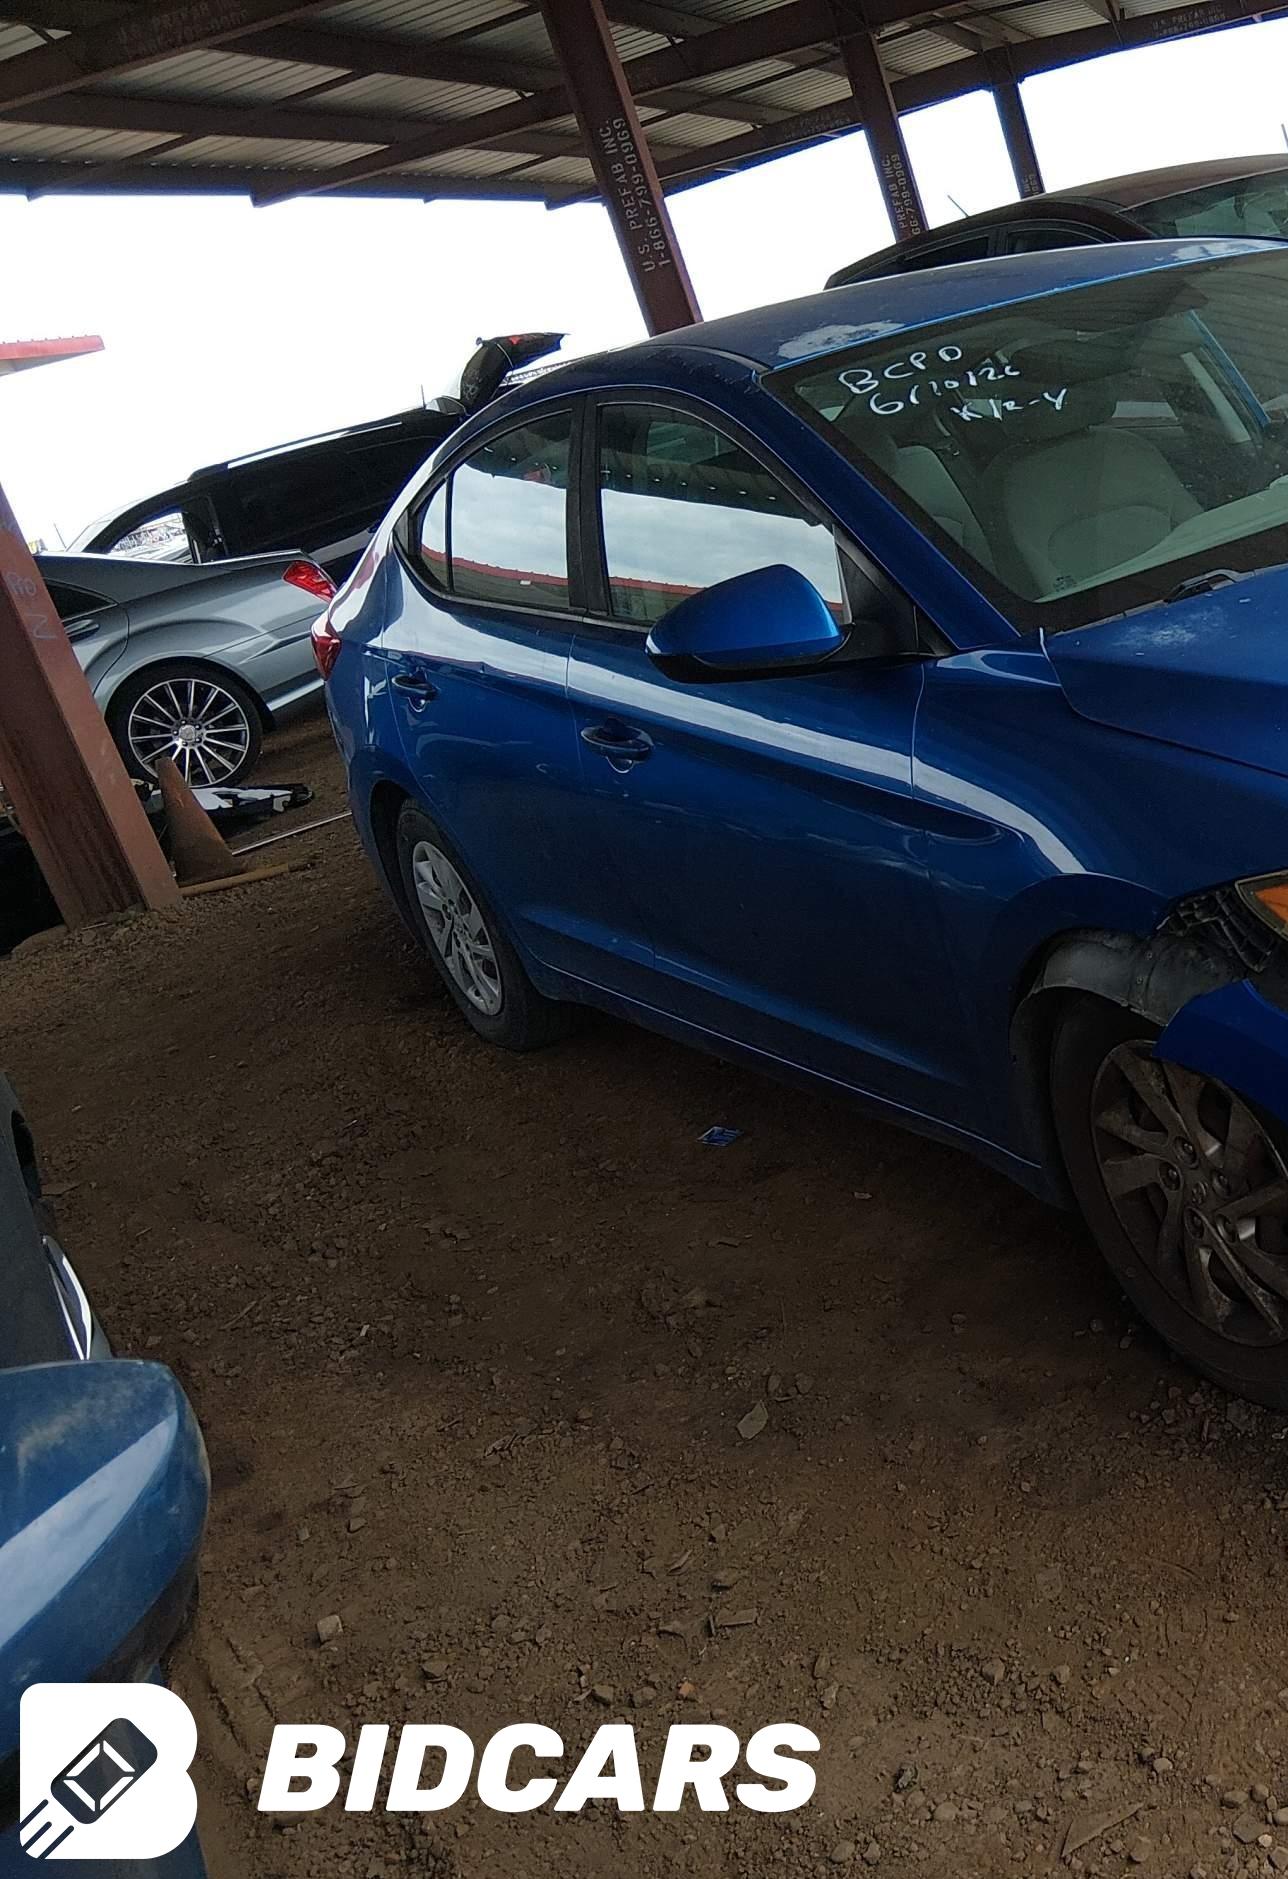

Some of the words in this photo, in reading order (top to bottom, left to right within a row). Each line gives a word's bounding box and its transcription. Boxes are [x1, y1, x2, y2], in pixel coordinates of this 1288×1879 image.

[600, 120, 618, 155] INC.
[611, 163, 643, 231] PREFAB
[613, 118, 671, 267] 1-866-799-0969
[888, 184, 908, 229] PREFAB
[890, 153, 921, 235] 66-799-0969
[639, 238, 656, 272] U.S.
